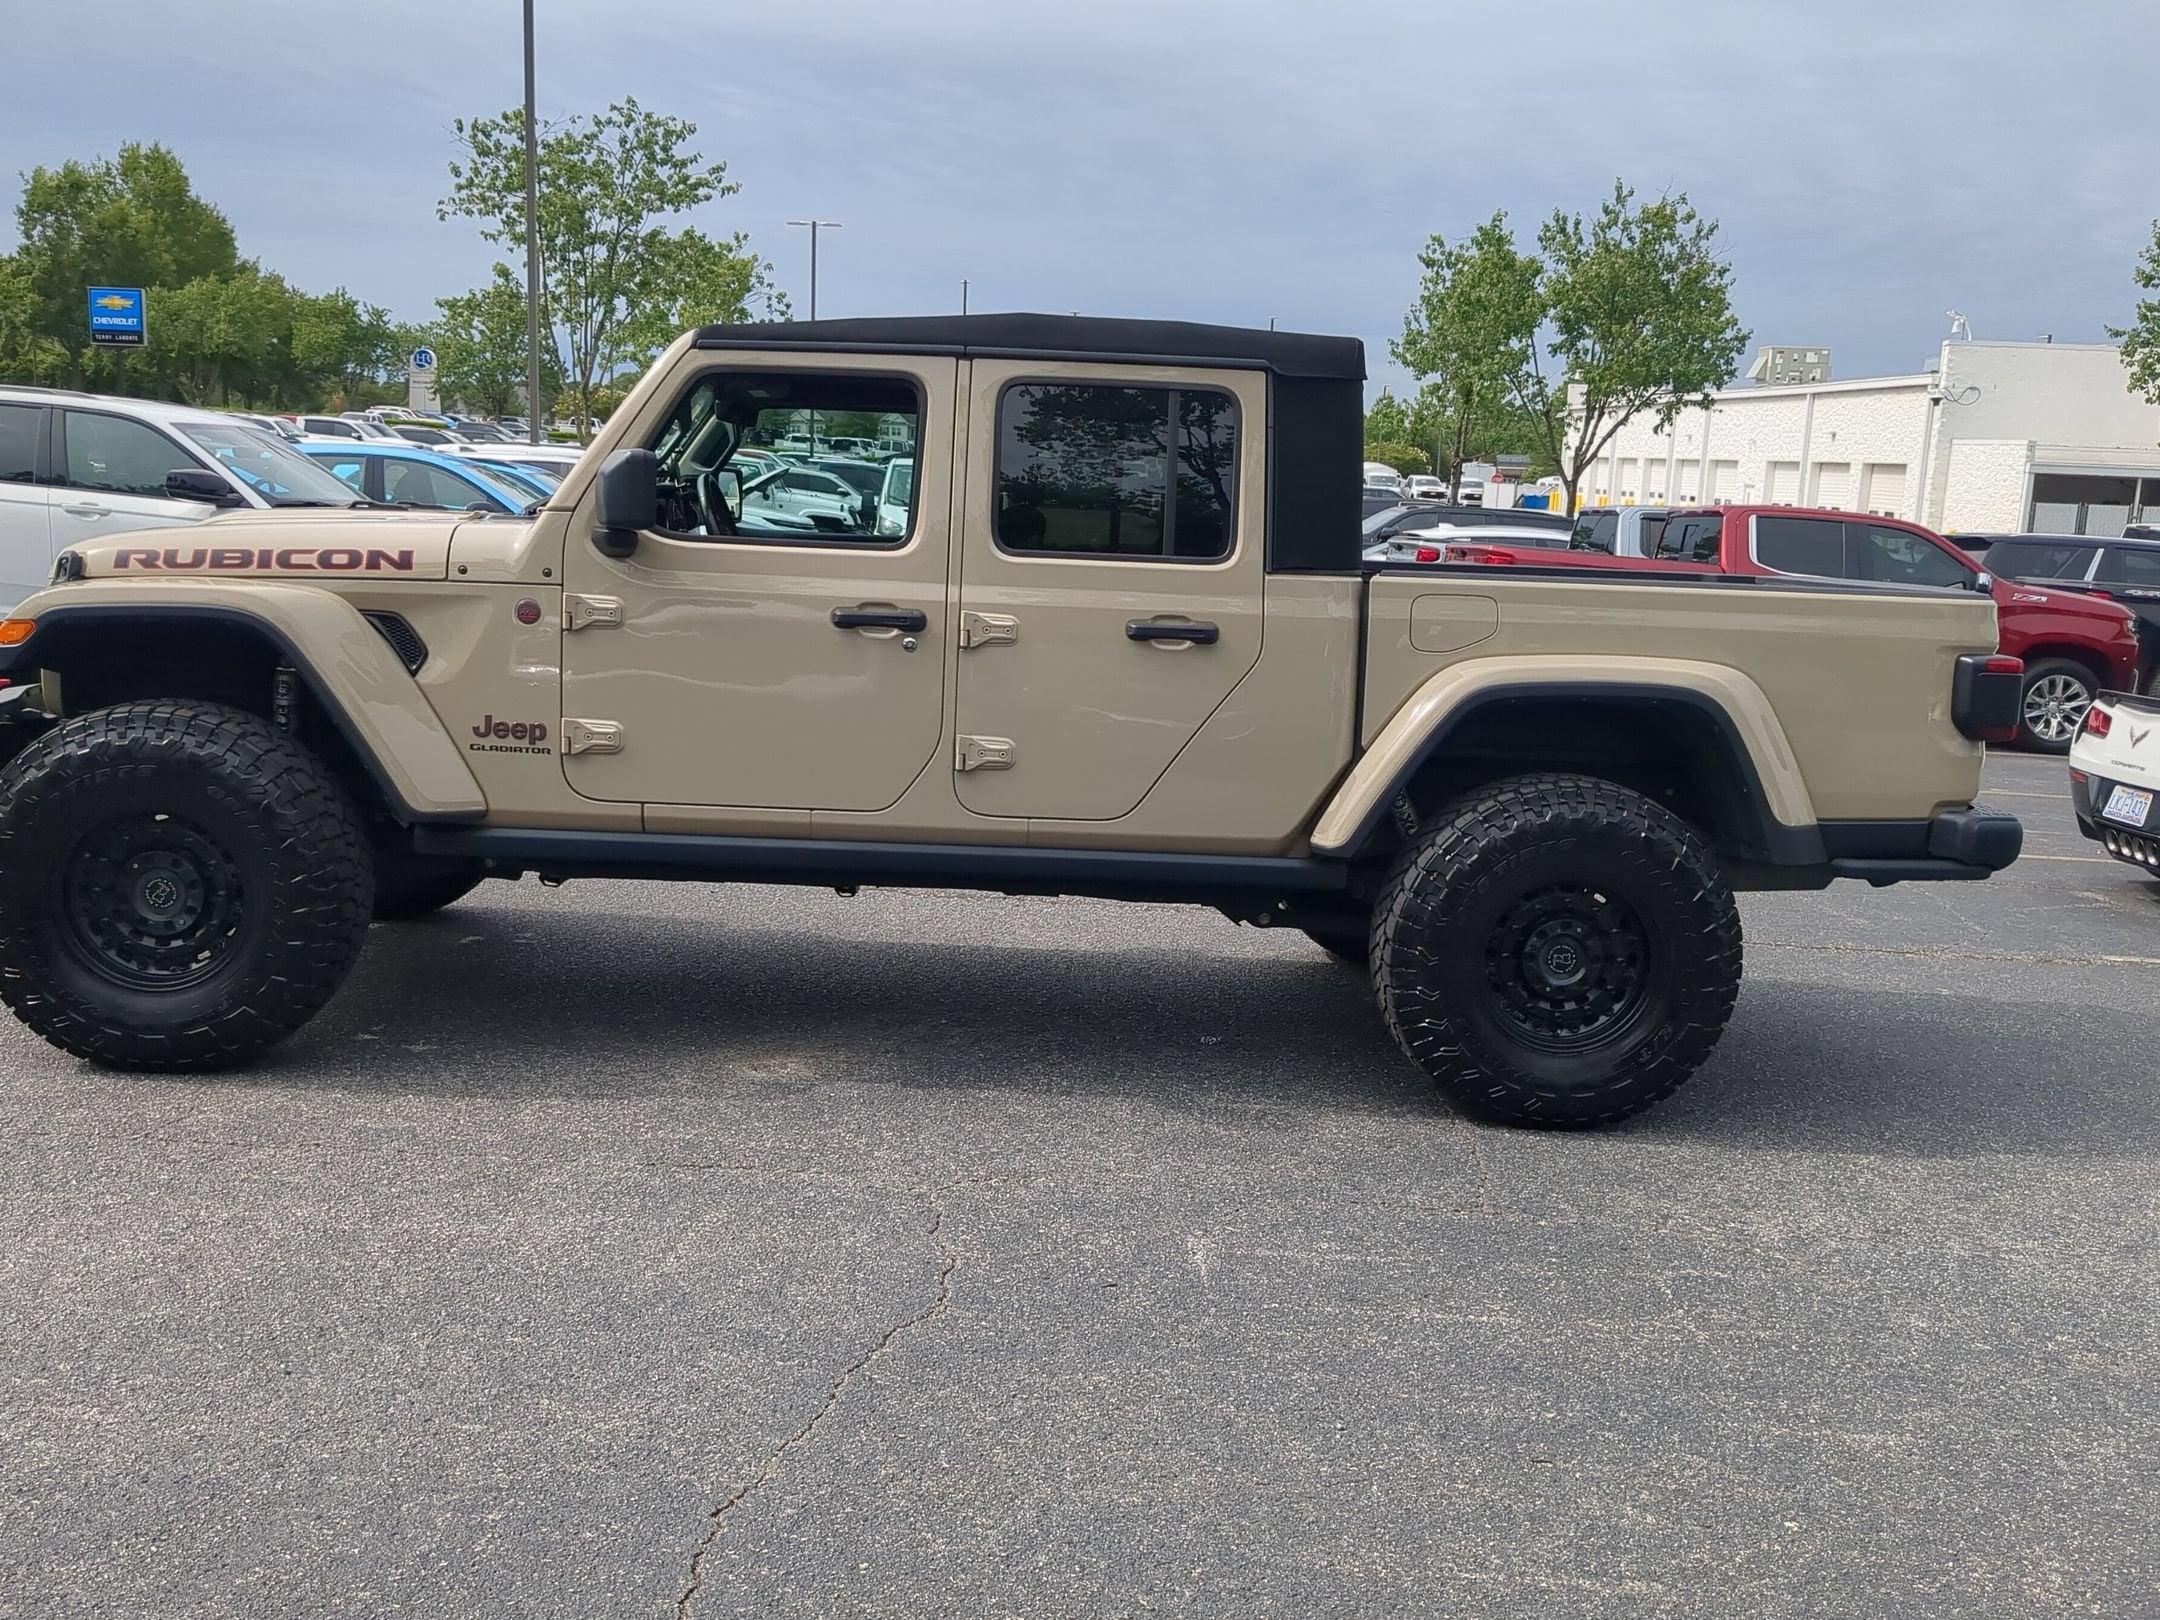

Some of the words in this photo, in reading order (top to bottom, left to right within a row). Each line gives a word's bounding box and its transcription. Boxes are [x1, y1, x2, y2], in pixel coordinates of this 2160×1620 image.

[93, 317, 138, 326] CHEVROLET
[112, 548, 415, 571] RUBICON
[472, 714, 547, 745] Jeep
[469, 743, 552, 755] GLADIATOR
